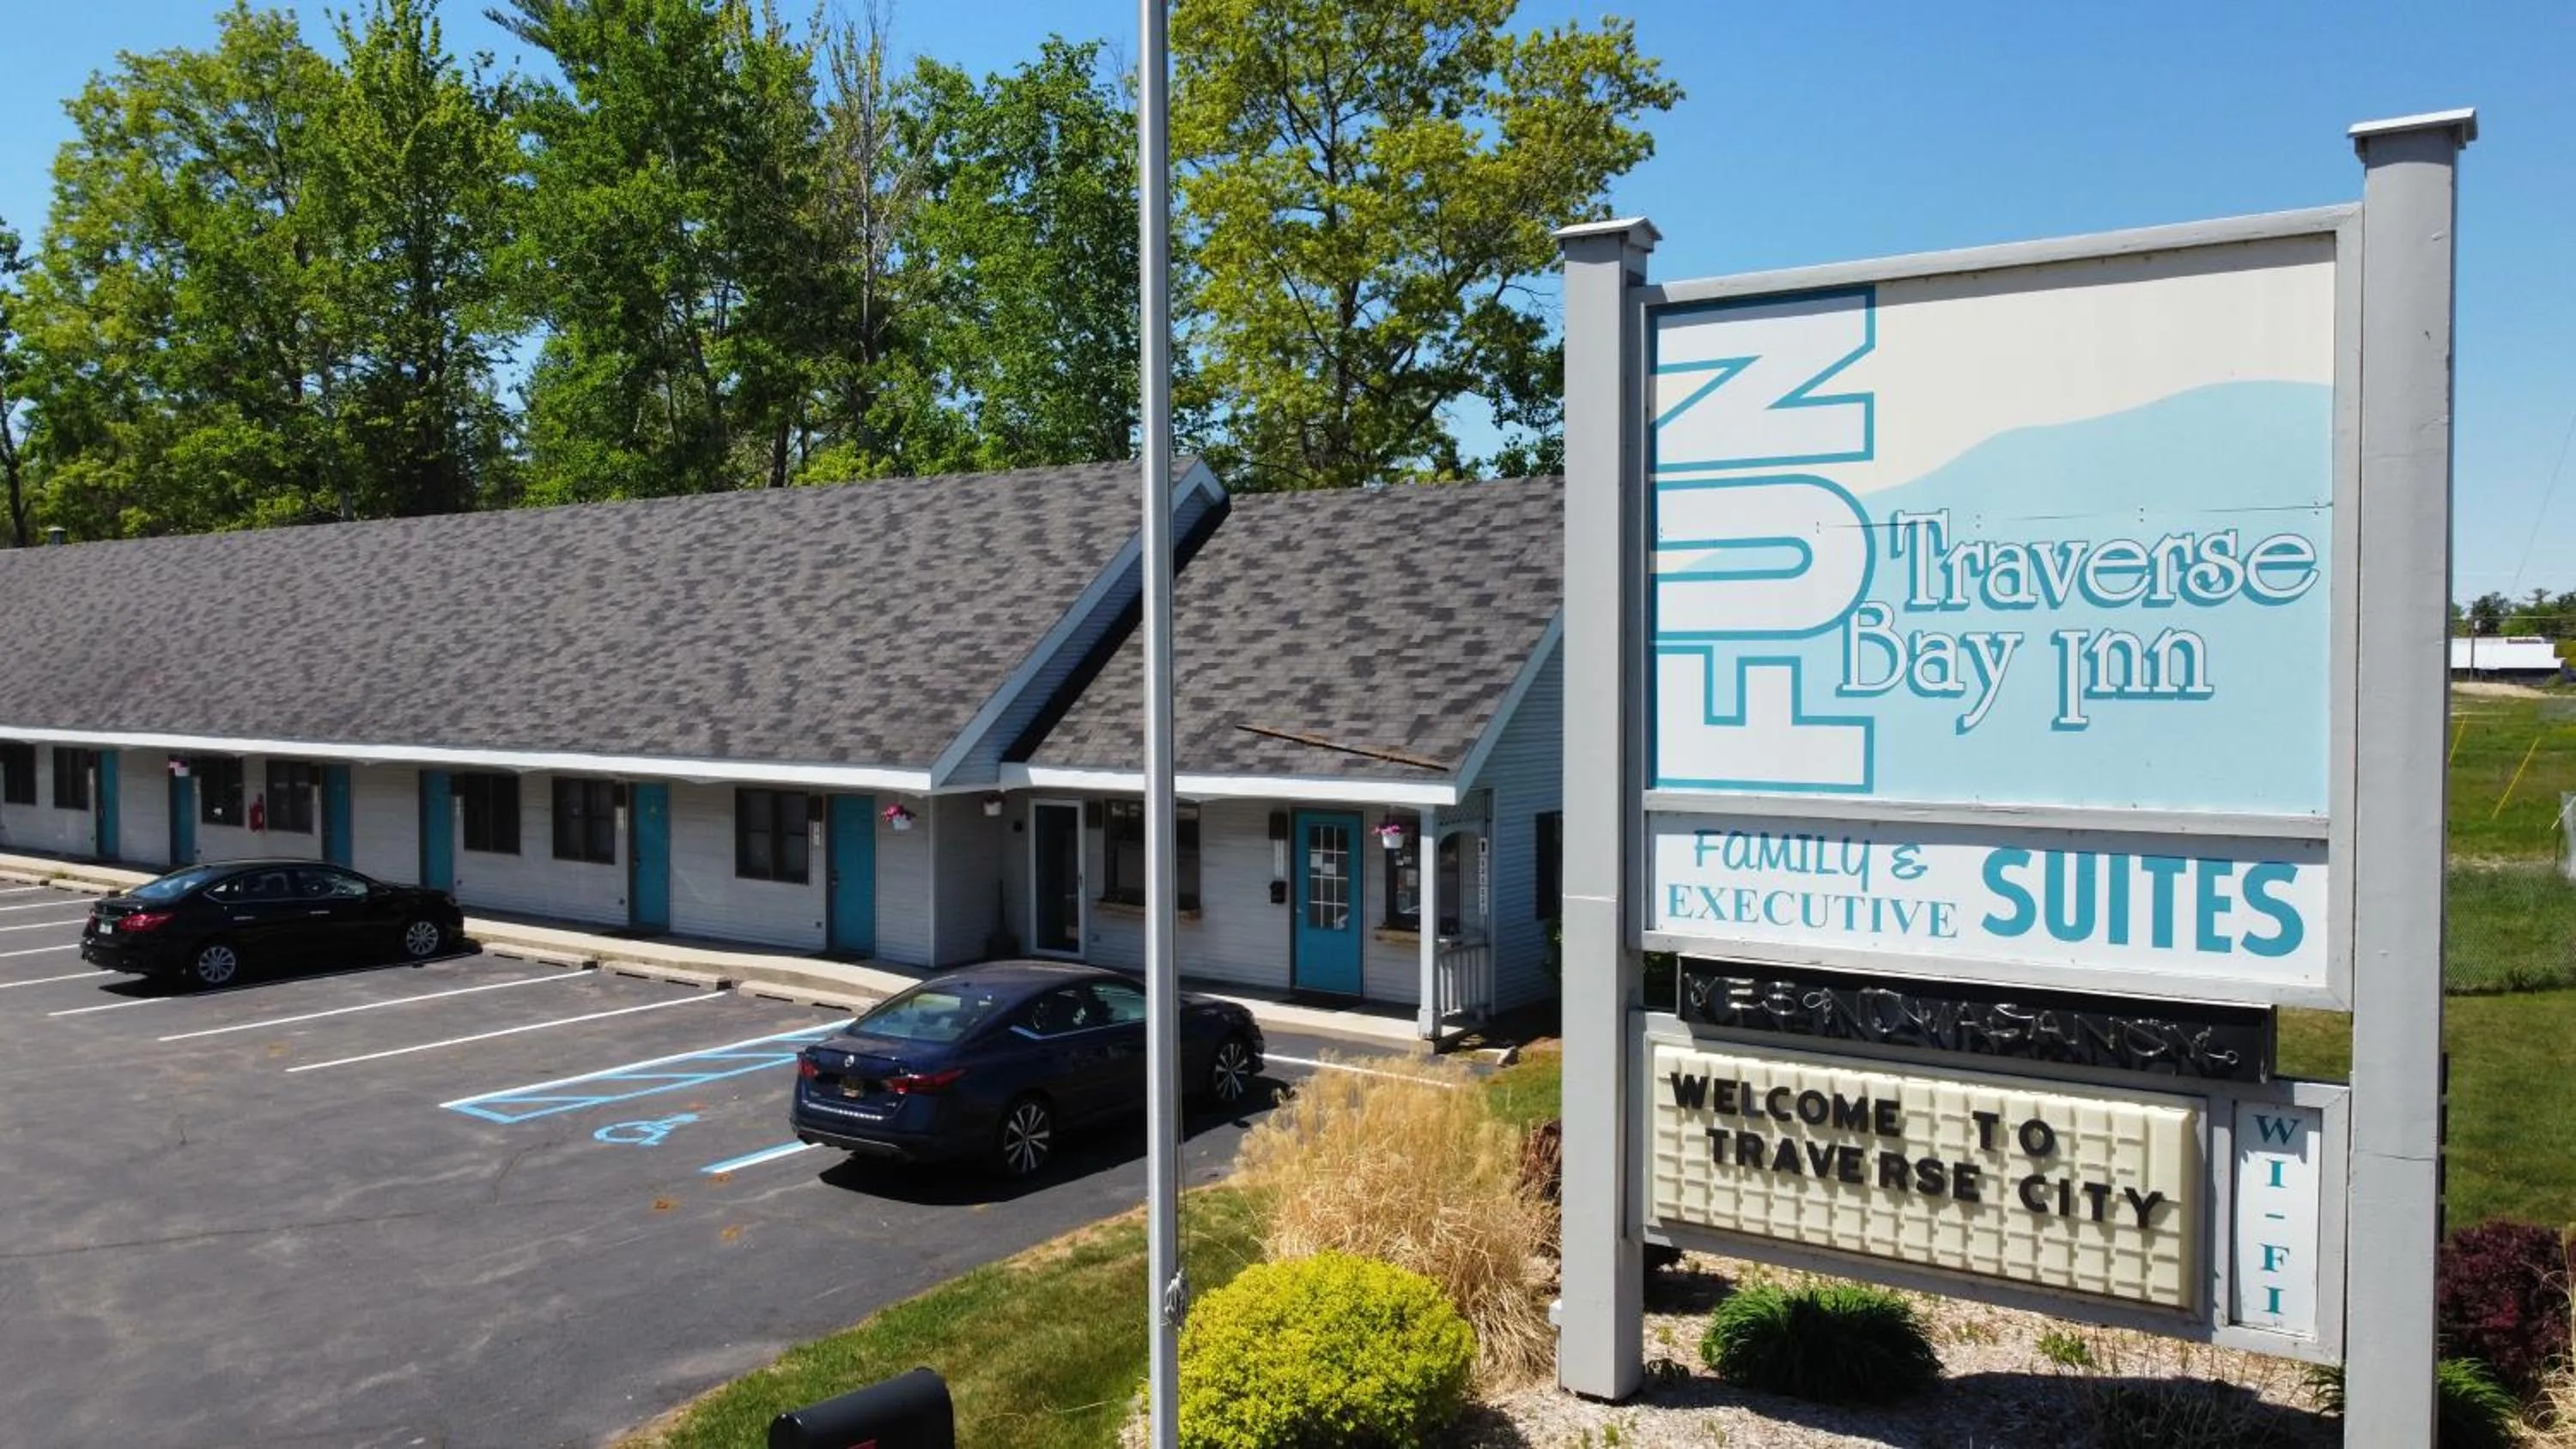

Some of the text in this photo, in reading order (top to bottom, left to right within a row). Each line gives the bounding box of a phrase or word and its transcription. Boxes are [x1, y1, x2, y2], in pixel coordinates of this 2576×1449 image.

[1649, 286, 1875, 792] FUN
[1890, 507, 2320, 610] Traverse
[1836, 601, 2214, 735] Bay Inn
[1667, 883, 1958, 939] EXECUTIVE
[1890, 841, 1929, 881] &
[1980, 845, 2305, 957] SUITES
[1670, 1071, 2055, 1157] WELCOME TO
[1705, 1127, 2164, 1228] TRAVERSE CITY
